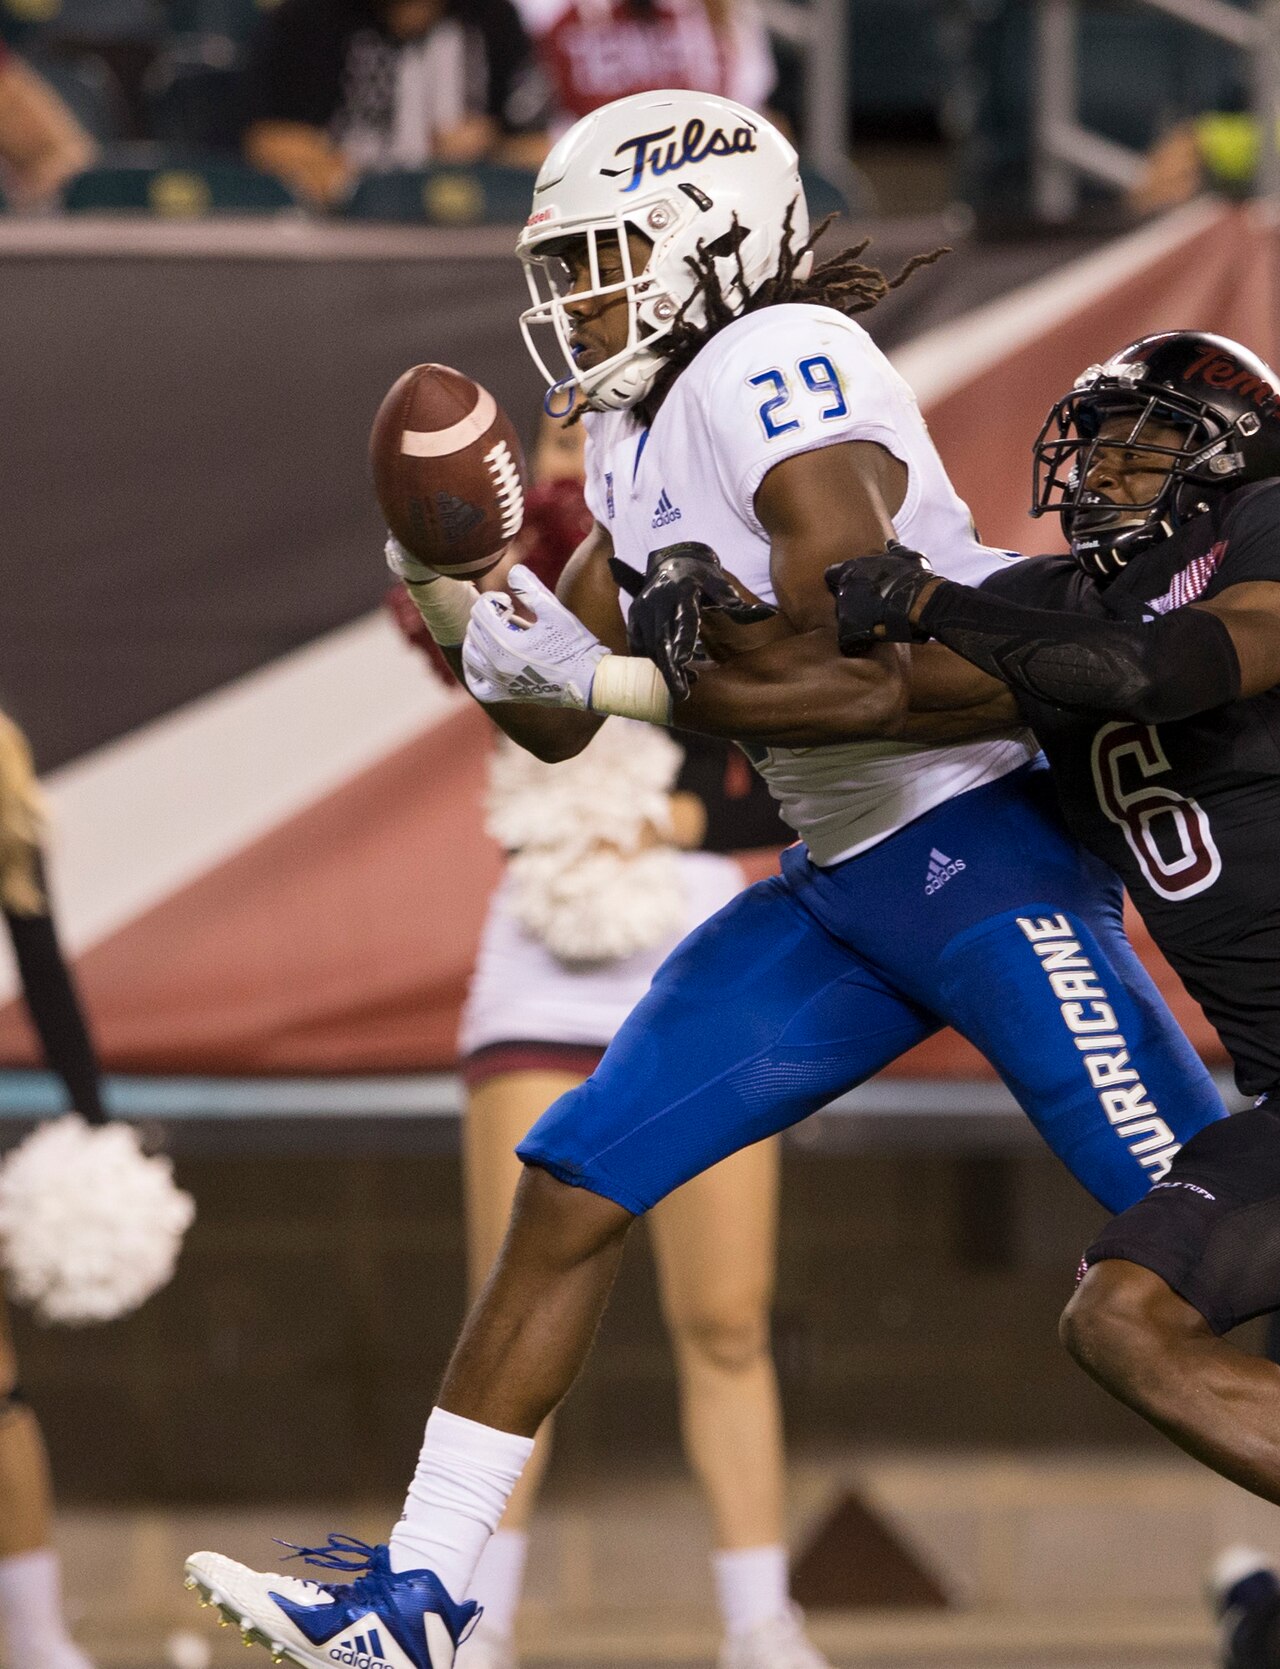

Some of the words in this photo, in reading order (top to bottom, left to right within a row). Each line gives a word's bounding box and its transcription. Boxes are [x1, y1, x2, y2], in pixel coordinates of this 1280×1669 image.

[614, 118, 757, 193] Tulsa
[746, 352, 852, 443] 29
[651, 508, 682, 529] adidas
[508, 684, 561, 697] adidas
[1091, 721, 1222, 902] 6
[925, 859, 966, 896] adidas
[1015, 911, 1184, 1184] HURRICANE
[1184, 1183, 1216, 1201] TUFF
